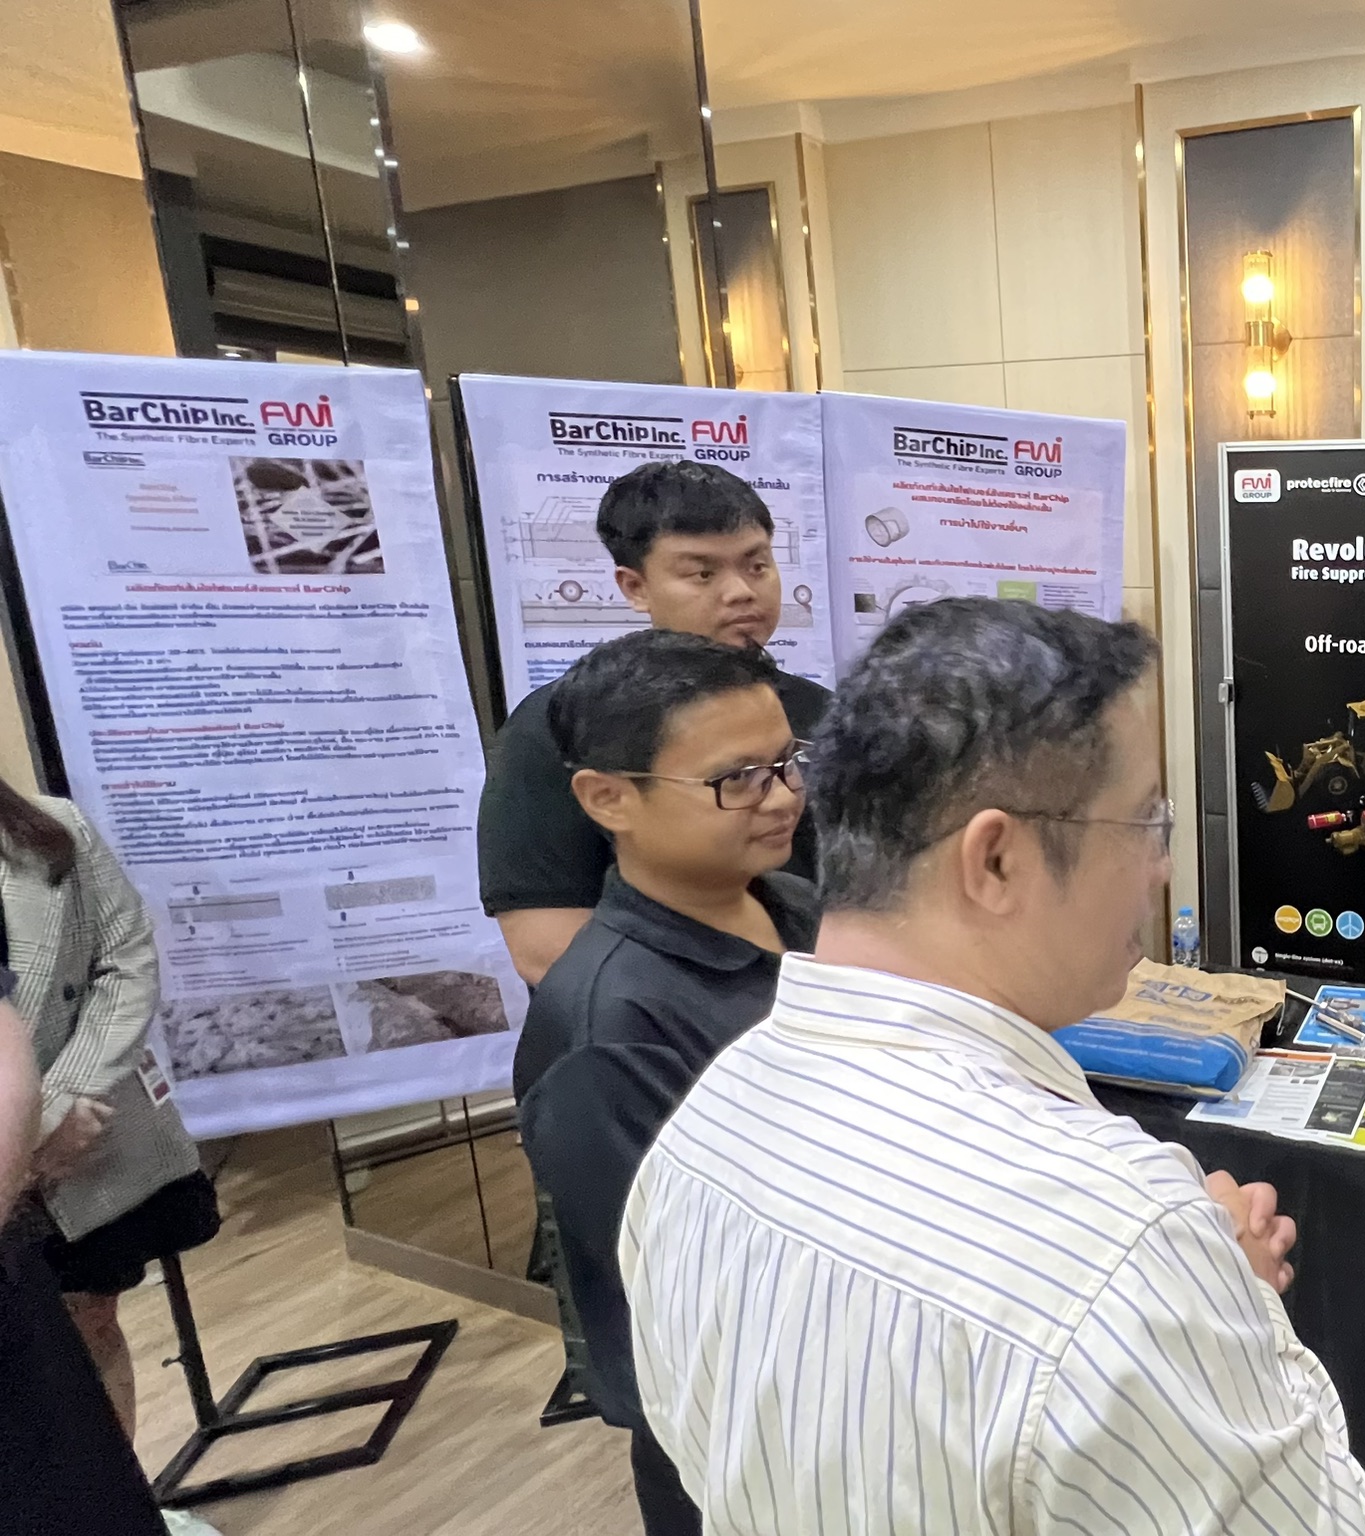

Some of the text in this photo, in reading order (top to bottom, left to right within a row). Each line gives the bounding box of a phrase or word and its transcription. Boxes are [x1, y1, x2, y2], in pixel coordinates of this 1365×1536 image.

[83, 399, 255, 427] BarChip Inc.
[550, 418, 686, 444] BarChip Inc.
[96, 431, 256, 446] The Synthetic Fibre Experts
[268, 433, 338, 447] GROUP
[893, 432, 1009, 461] BarChip Inc.
[558, 448, 684, 461] The Synthetic Fibre Experts
[694, 449, 750, 461] GROUP
[897, 459, 912, 467] The
[914, 459, 950, 471] Synthetic
[952, 464, 974, 472] Fibre
[1015, 465, 1063, 478] GROUP
[1286, 477, 1352, 491] protecfire
[1033, 492, 1070, 504] BarChip
[1291, 565, 1319, 580] Fire
